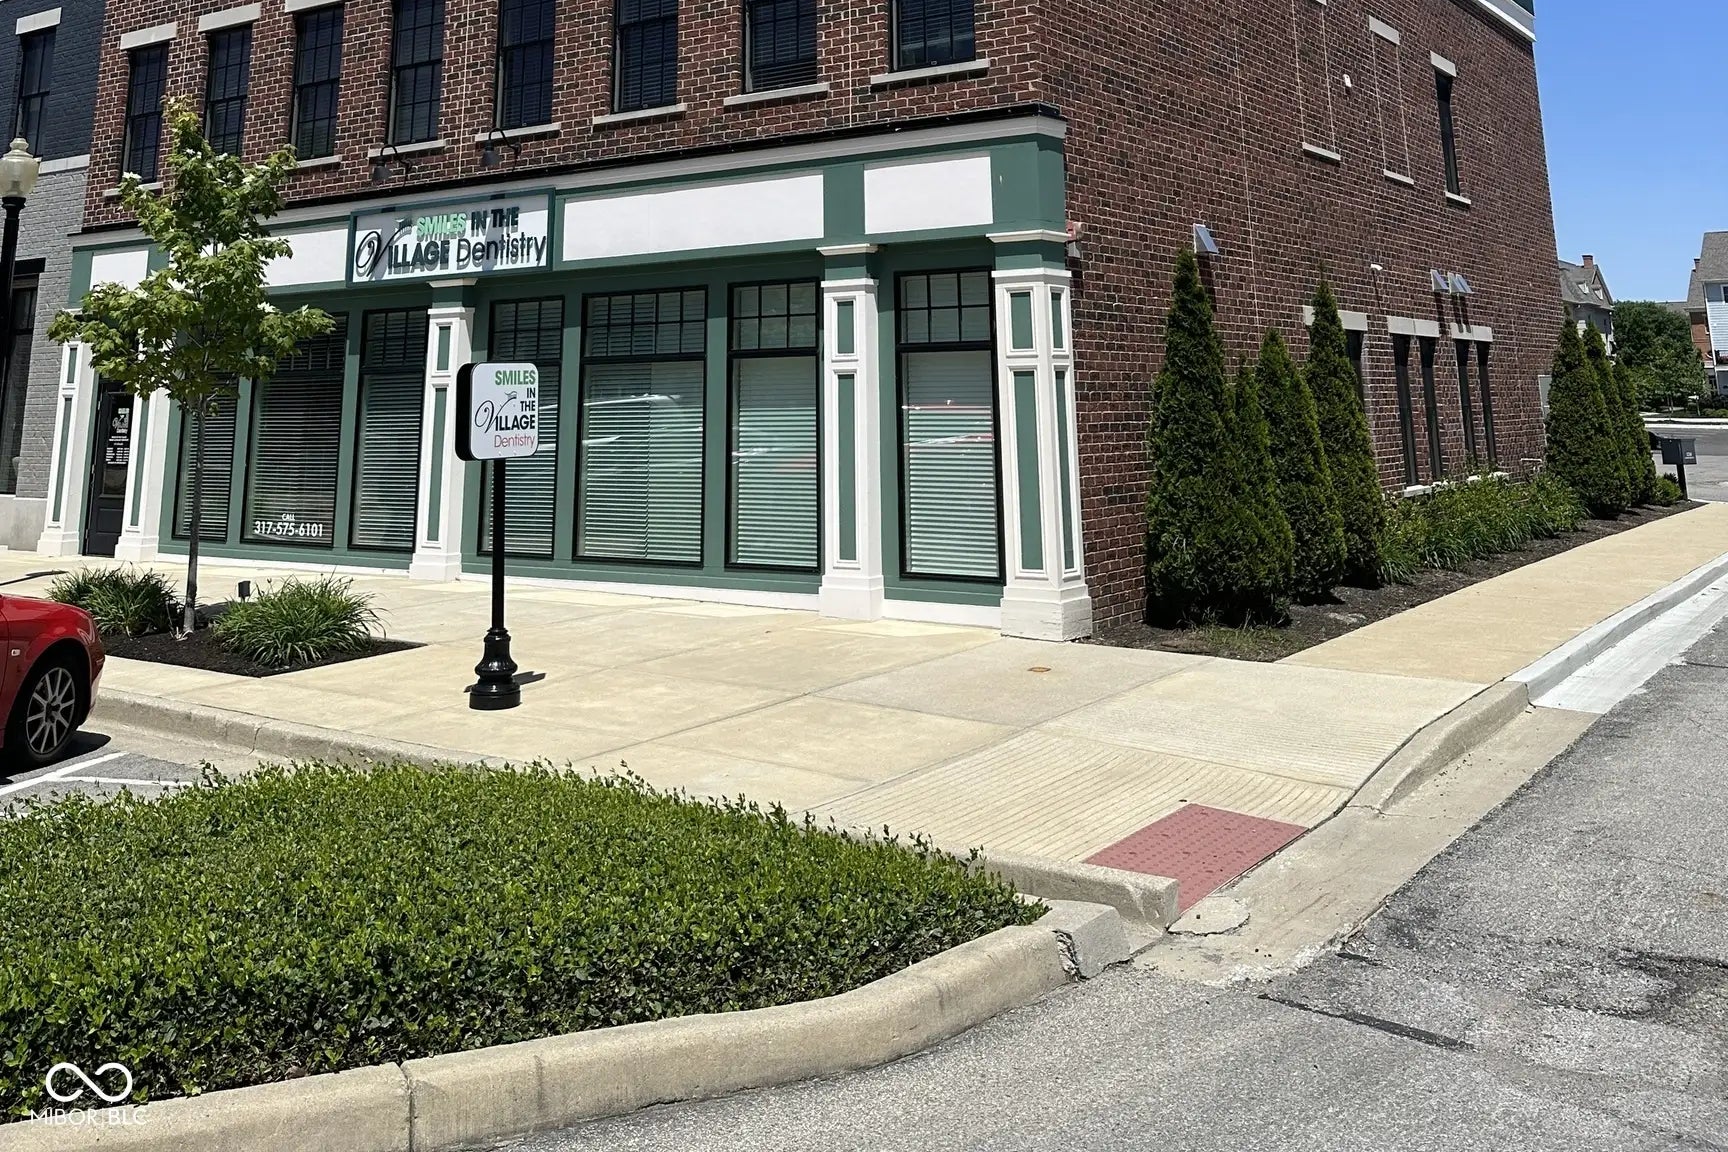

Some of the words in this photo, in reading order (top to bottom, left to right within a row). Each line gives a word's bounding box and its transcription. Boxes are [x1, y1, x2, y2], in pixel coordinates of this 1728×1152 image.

[416, 213, 466, 236] SMILES
[471, 210, 487, 231] IN
[491, 206, 520, 228] THE
[355, 224, 450, 278] VILLAGE
[456, 232, 547, 263] Dentistry
[495, 370, 536, 385] SMILES
[526, 388, 536, 399] IN
[520, 401, 536, 412] THE
[475, 397, 536, 434] VILLAGE
[494, 435, 535, 448] Dentistry
[281, 513, 295, 521] CALL
[254, 521, 323, 537] 317-575-6101
